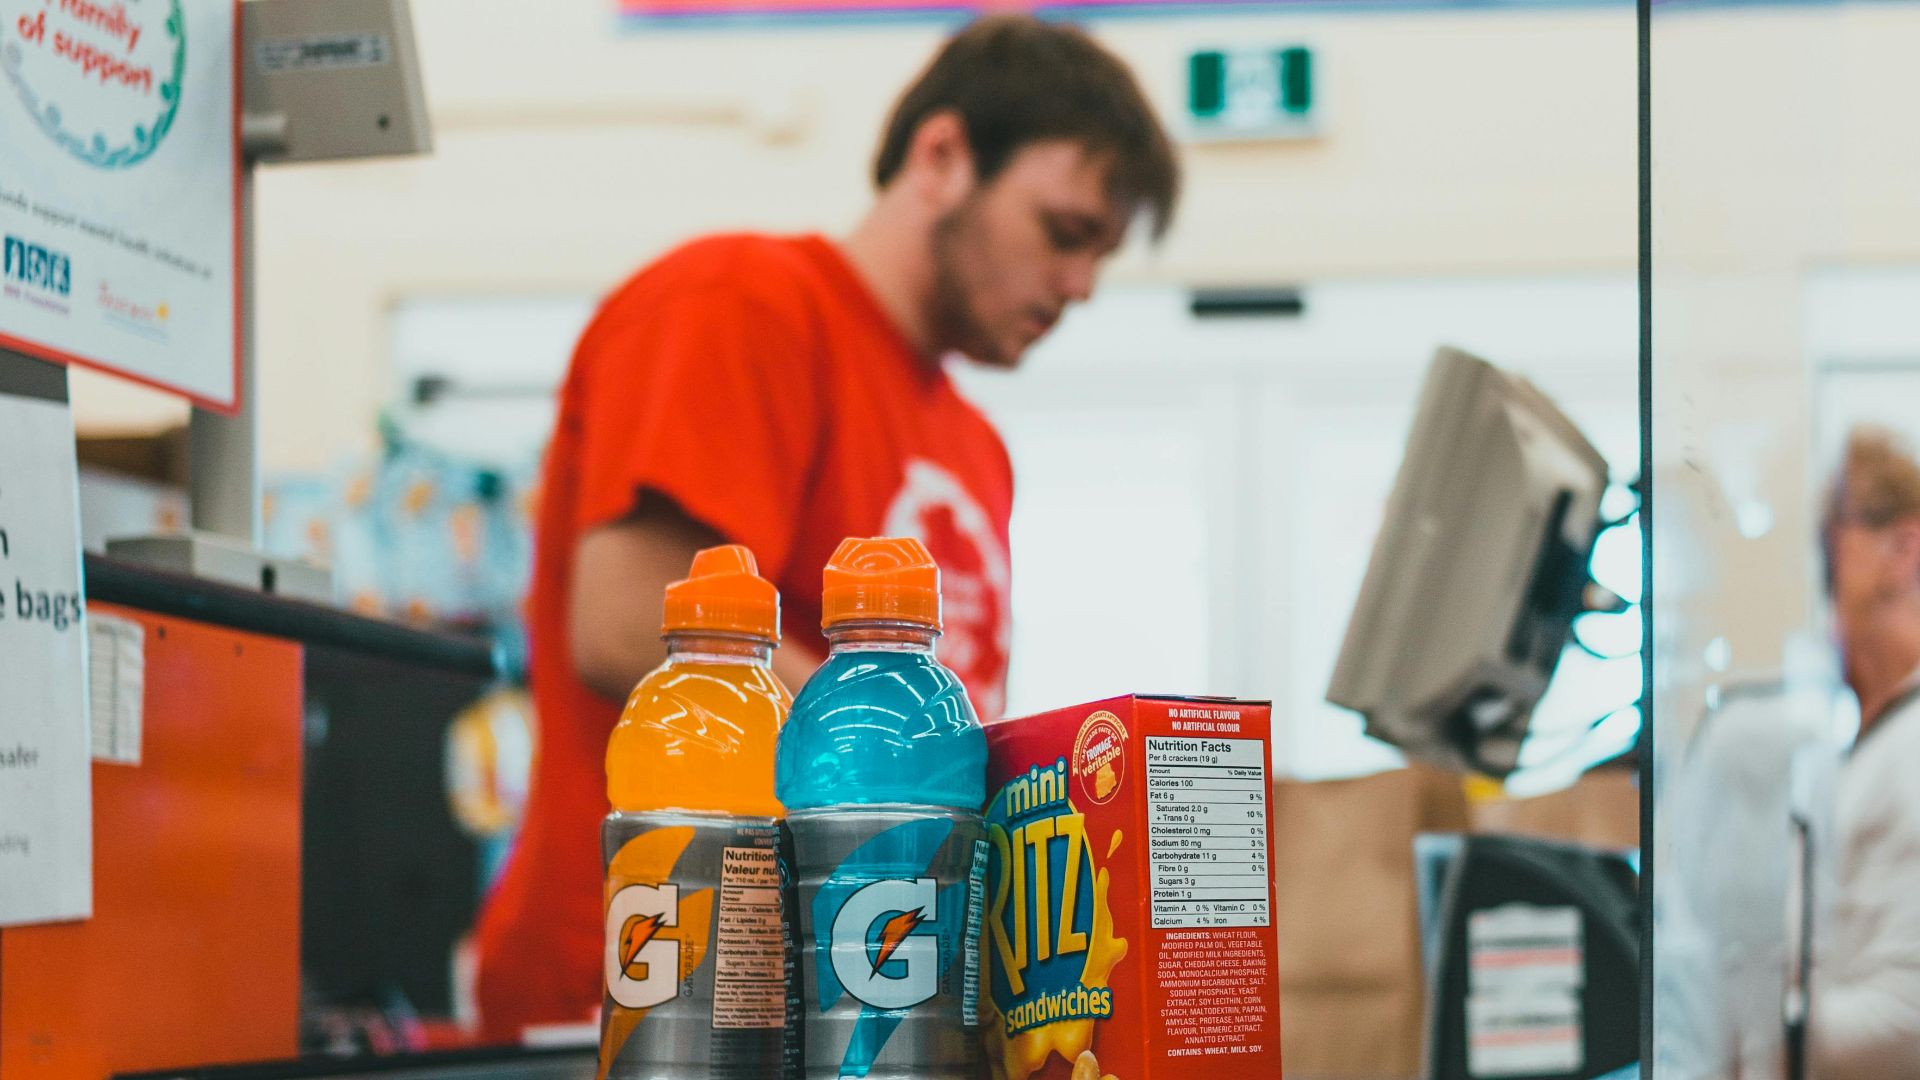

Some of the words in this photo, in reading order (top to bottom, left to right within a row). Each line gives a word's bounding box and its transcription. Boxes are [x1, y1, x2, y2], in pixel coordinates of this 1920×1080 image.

[57, 0, 141, 54] amily
[17, 10, 45, 47] of
[53, 31, 153, 96] support
[16, 575, 82, 632] bags
[1169, 709, 1178, 717] NO
[1180, 709, 1212, 719] ARTIFICIAL
[1213, 711, 1240, 720] FLAVOUR
[1172, 721, 1181, 730] NO
[1183, 722, 1215, 731] ARTIFICIAL
[1217, 723, 1240, 732] COLOUR
[1087, 736, 1112, 762] FROMAGE
[1149, 740, 1197, 752] Nutrition
[1202, 742, 1231, 752] Facts
[1082, 746, 1121, 777] véritable
[1006, 762, 1066, 816] mini
[726, 850, 774, 861] Nutrition
[1152, 852, 1200, 861] Carbohydrate
[724, 864, 760, 875] Valeur
[763, 867, 778, 876] nu
[988, 812, 1087, 995] RITZ
[1166, 932, 1212, 940] INGREDIENTS:
[1237, 931, 1257, 939] FLOUR,
[604, 883, 679, 1009] G
[830, 877, 938, 1010] G
[1162, 942, 1193, 950] MODIFIED
[1215, 941, 1226, 949] OIL,
[1159, 951, 1171, 959] OIL,
[1223, 949, 1265, 958] INGREDIENTS,
[684, 938, 694, 998] GATORADE
[1158, 961, 1182, 969] SUGAR,
[1179, 969, 1228, 978] MONOCALCIUM
[1160, 980, 1200, 988] AMMONIUM
[1007, 988, 1112, 1034] sandwiches
[1161, 1008, 1189, 1017] STARCH,
[1190, 1007, 1241, 1016] MALTODEXTRIN,
[1200, 1026, 1232, 1034] TURMERIC
